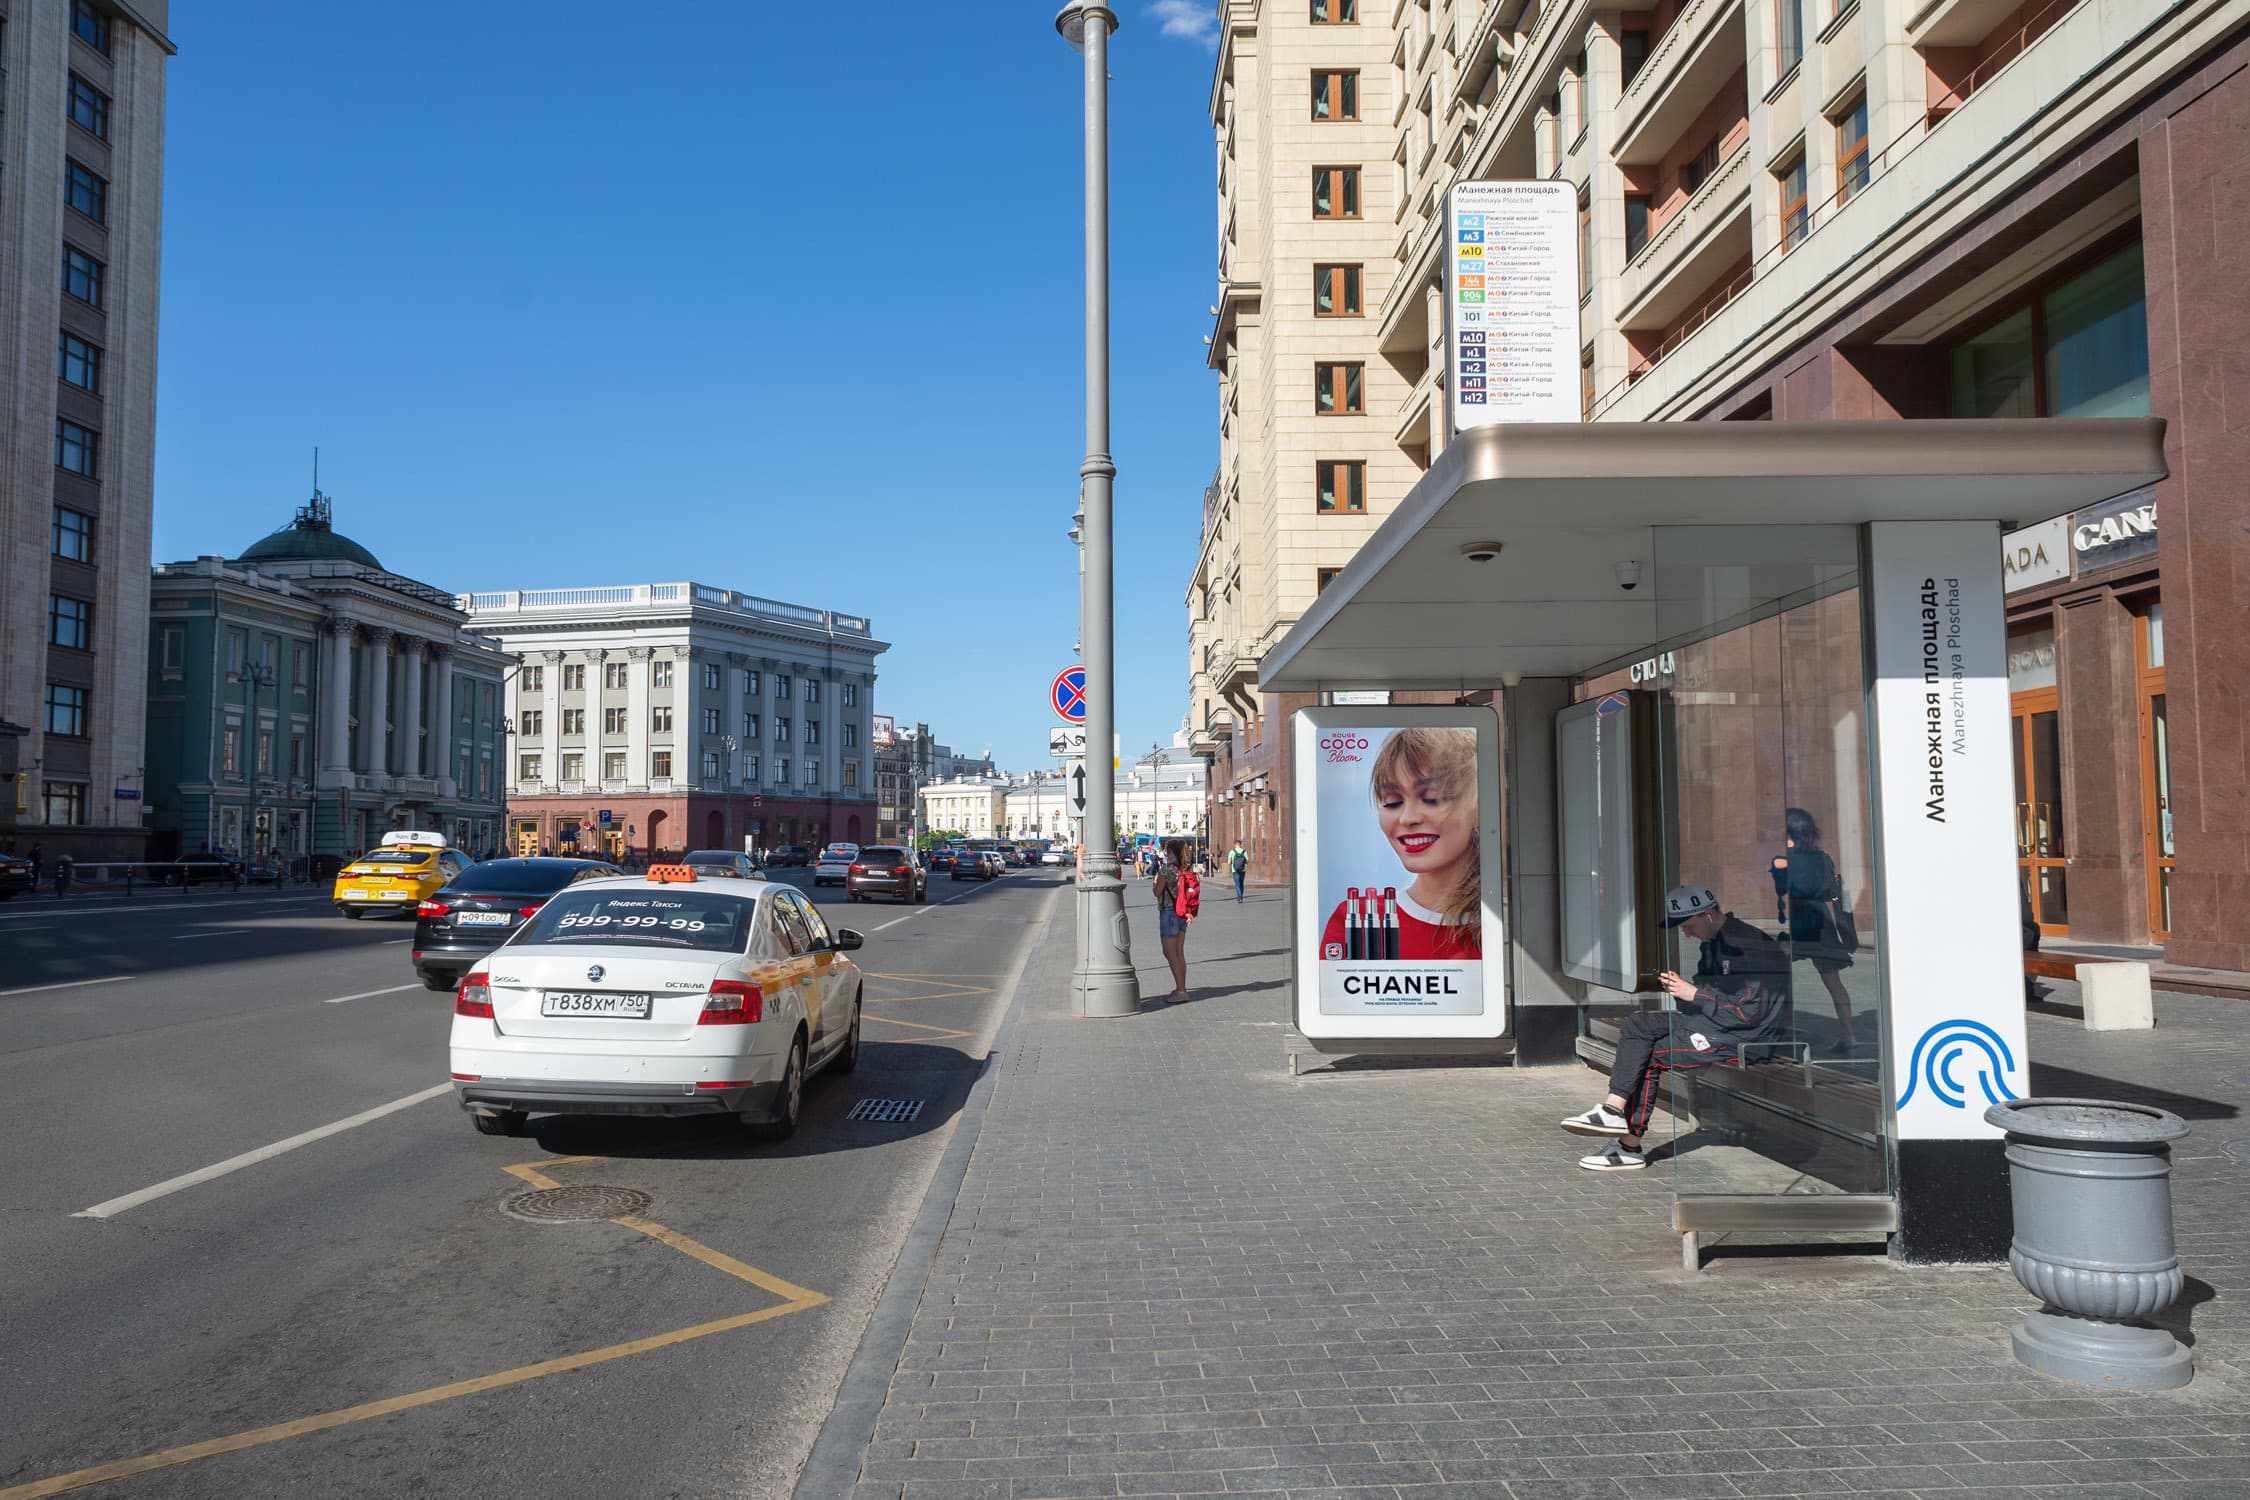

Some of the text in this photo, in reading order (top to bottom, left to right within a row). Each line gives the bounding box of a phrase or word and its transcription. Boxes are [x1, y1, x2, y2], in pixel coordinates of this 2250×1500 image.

[1458, 186, 1560, 195] Манежная площадь
[1464, 312, 1480, 321] 101
[1944, 577, 1966, 756] Manezhnaya Ploschad
[1921, 577, 1945, 823] Манежная площадь
[1320, 738, 1369, 750] COCO
[1327, 749, 1363, 763] Bloom
[558, 915, 706, 932] 999-99-99
[665, 981, 705, 989] OCTAVIA
[1343, 975, 1458, 995] CHANEL
[619, 994, 644, 1007] 750
